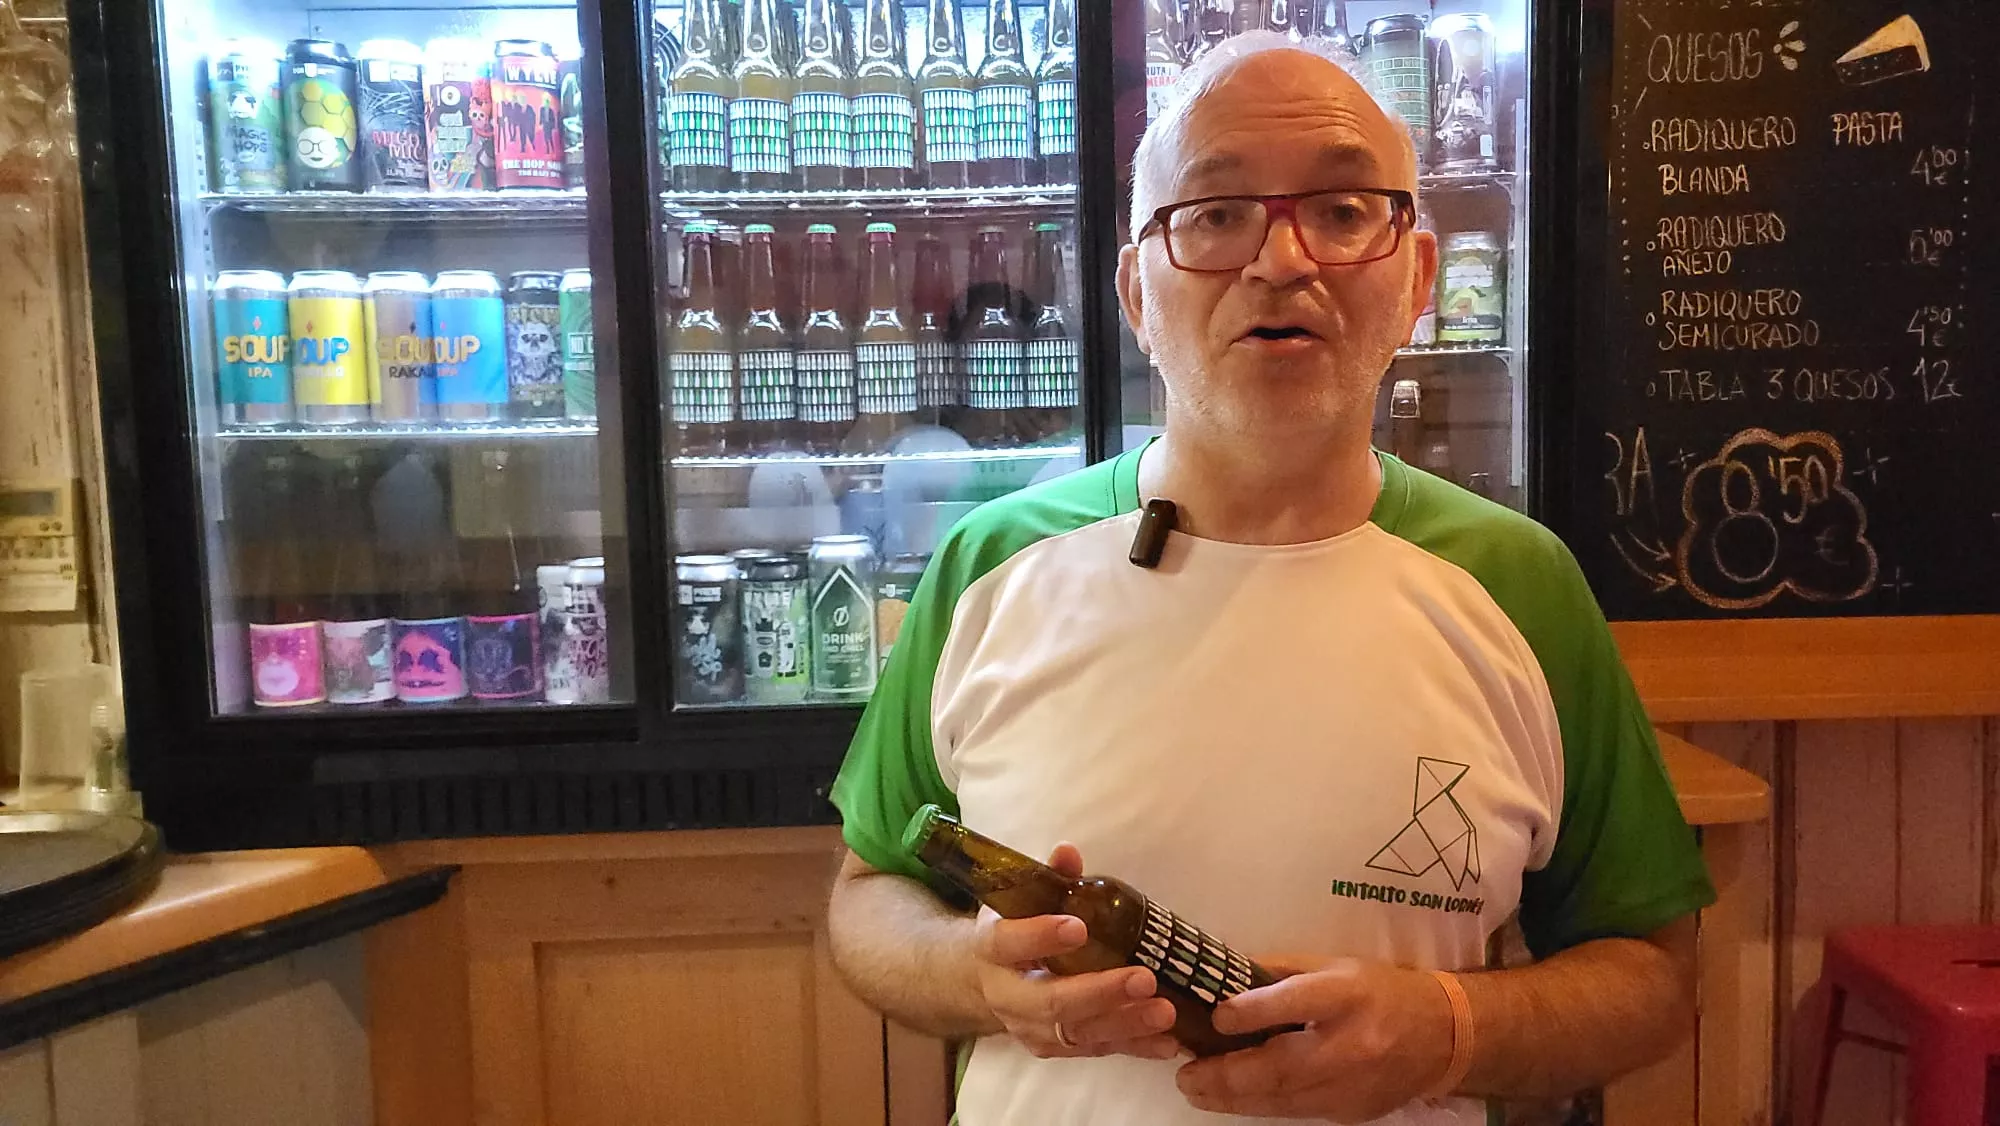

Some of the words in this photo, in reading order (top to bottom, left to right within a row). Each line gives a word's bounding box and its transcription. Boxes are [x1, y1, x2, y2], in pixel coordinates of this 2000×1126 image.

[1647, 28, 1763, 84] QUESOS
[1651, 115, 1796, 152] RADIQUERO
[1831, 111, 1903, 146] PASTA
[1658, 163, 1750, 195] BLANDA
[1657, 212, 1786, 250] RADIQUERO
[1662, 249, 1732, 277] AÑEJO
[1660, 289, 1801, 321] RADIQUERO
[296, 336, 349, 365] OUP
[1658, 320, 1820, 350] SEMICURADO
[248, 367, 273, 378] IPA
[1659, 368, 1747, 400] TABLA
[1765, 368, 1783, 400] 3
[1793, 366, 1896, 403] QUESOS
[822, 632, 864, 644] DRINK
[1410, 890, 1443, 911] SAN
